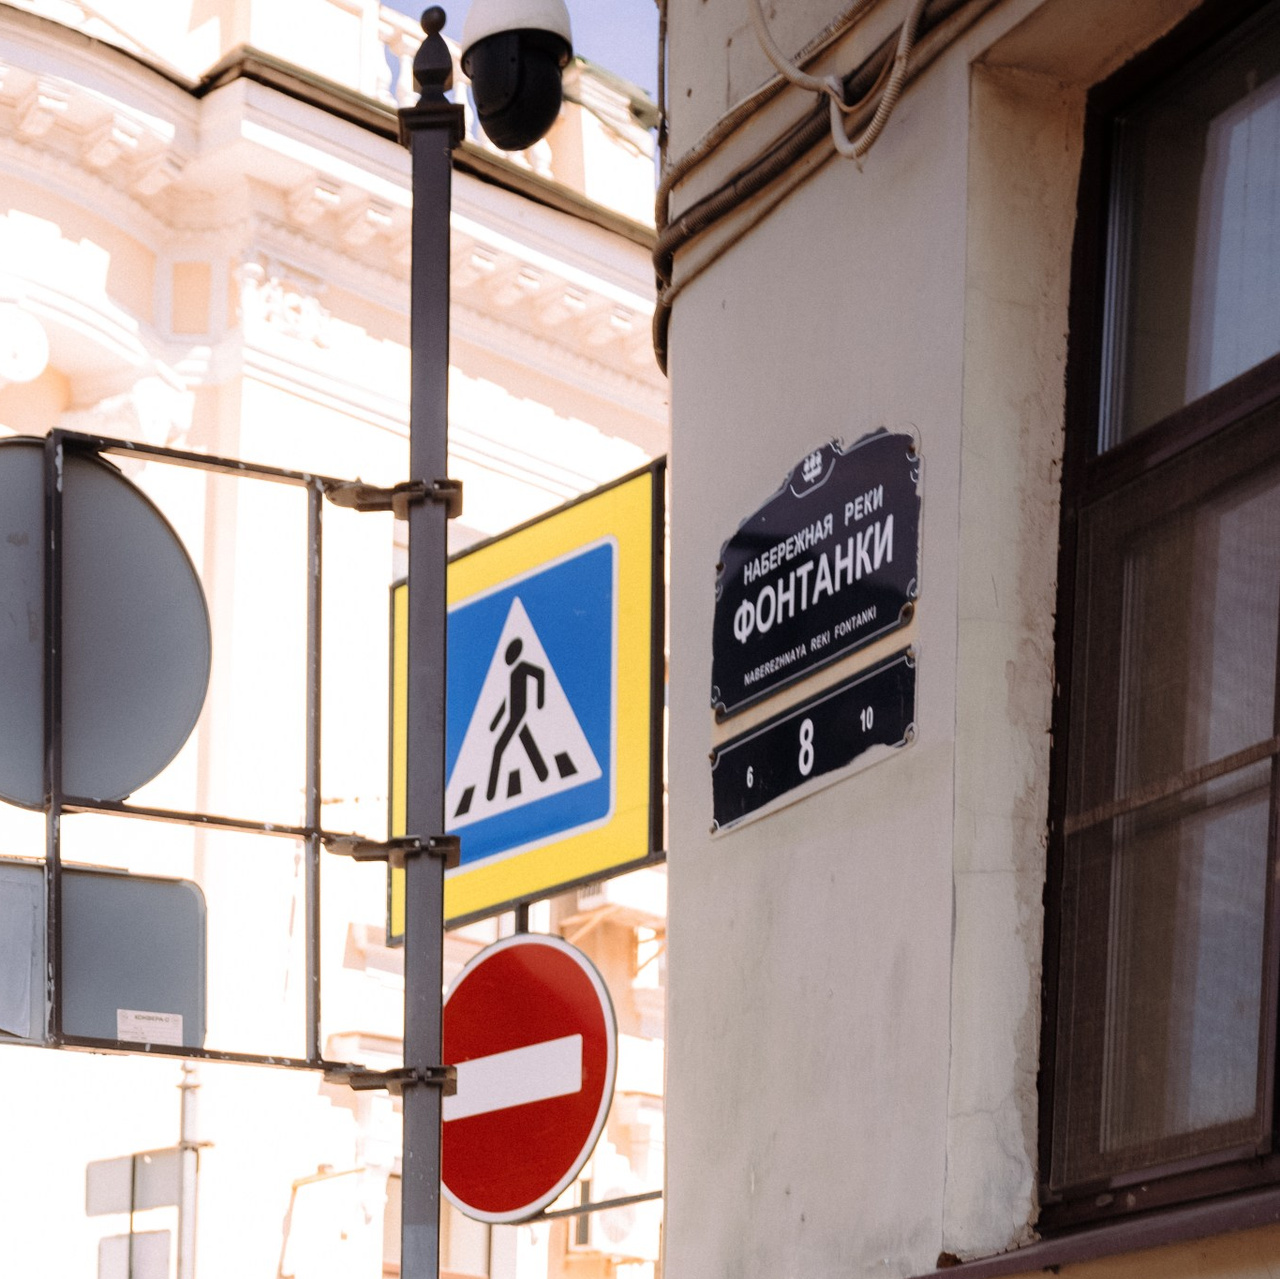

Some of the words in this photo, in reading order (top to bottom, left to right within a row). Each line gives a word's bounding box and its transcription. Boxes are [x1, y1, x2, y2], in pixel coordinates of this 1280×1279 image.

[733, 514, 894, 644] ФОНТАНКИ
[743, 514, 833, 585] НАБЕРЕЖНАЯ
[844, 485, 884, 526] РЕКИ
[744, 648, 807, 686] NABEREZHNAYA
[810, 630, 831, 652] REKI
[834, 605, 878, 640] FONTANKI
[746, 765, 754, 788] 6
[798, 717, 815, 776] 8
[859, 706, 874, 732] 10
